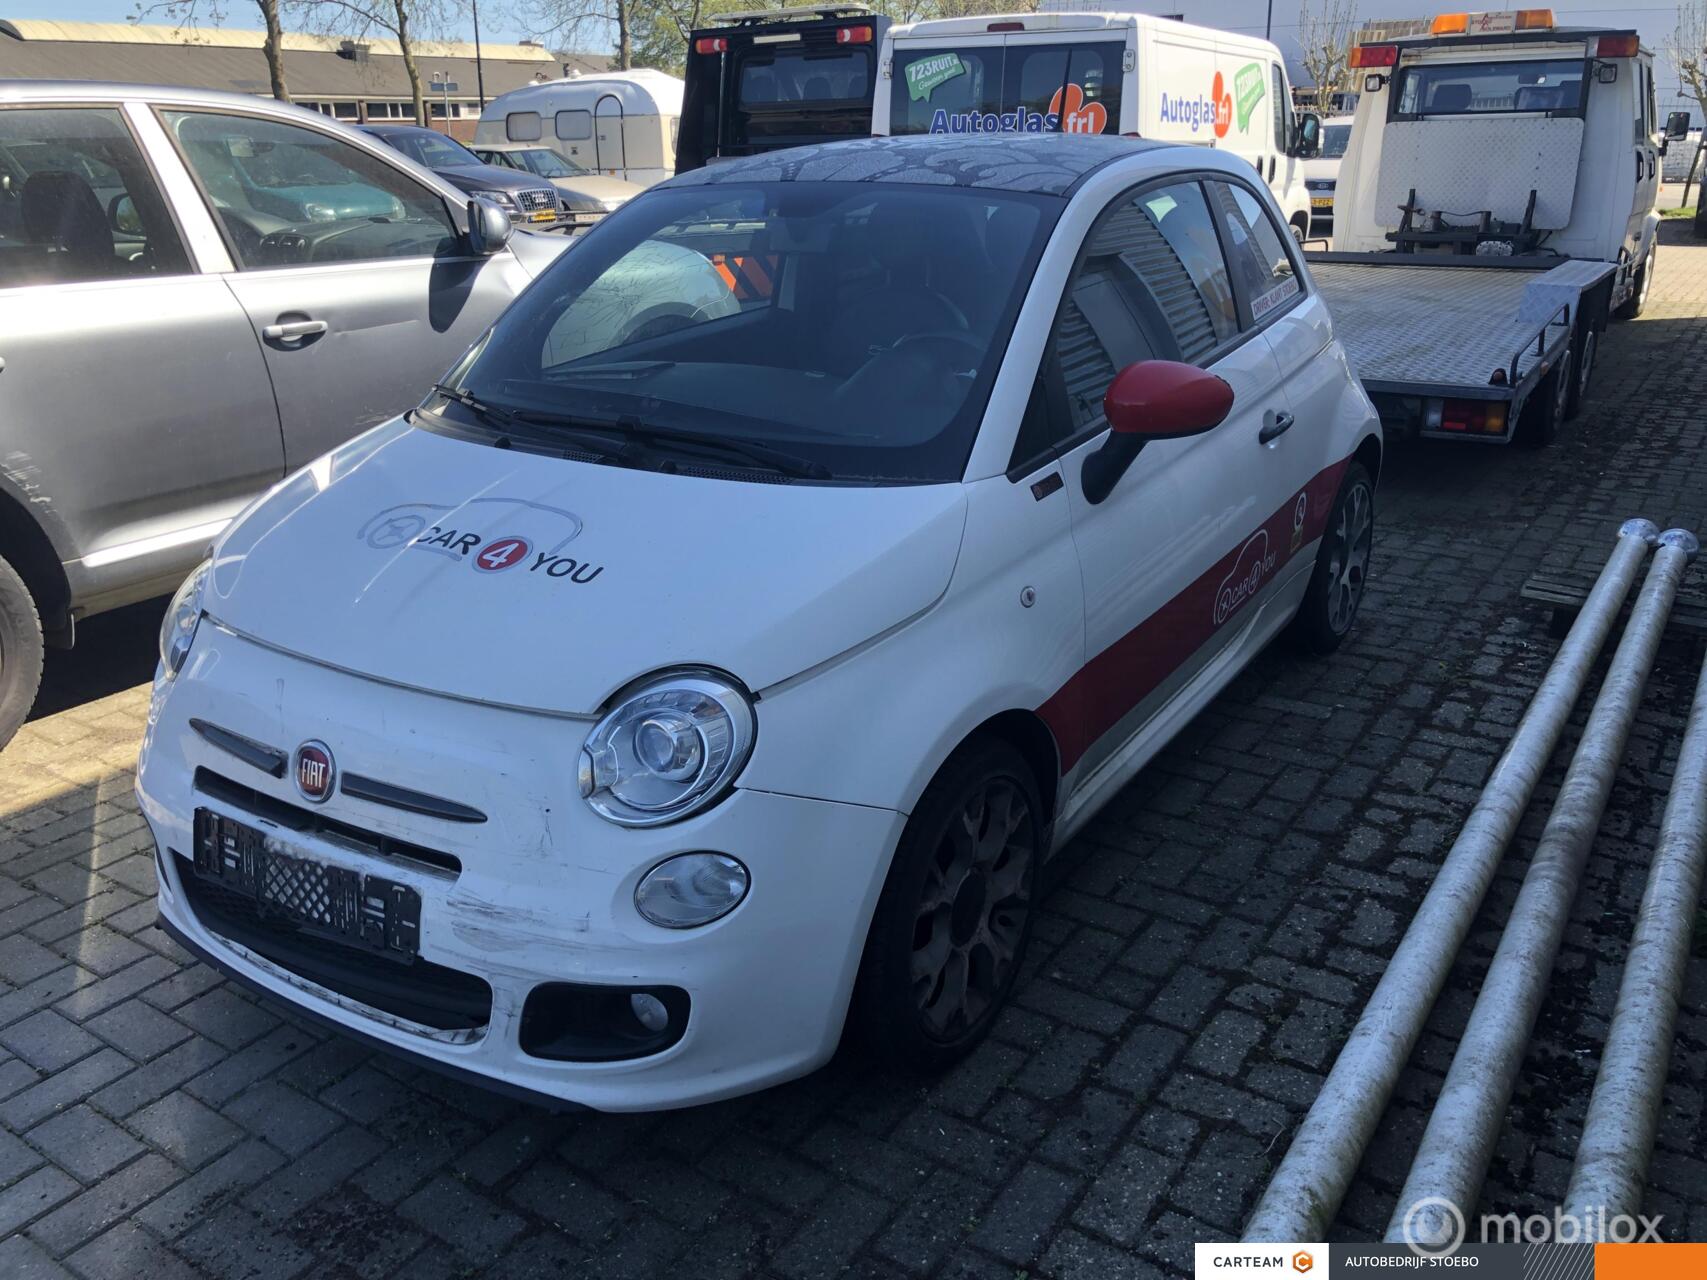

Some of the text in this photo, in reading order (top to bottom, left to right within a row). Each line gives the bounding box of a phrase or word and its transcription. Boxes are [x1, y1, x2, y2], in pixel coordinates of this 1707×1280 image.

[416, 526, 604, 583] CAR 4 YOU
[301, 758, 326, 788] FIAT
